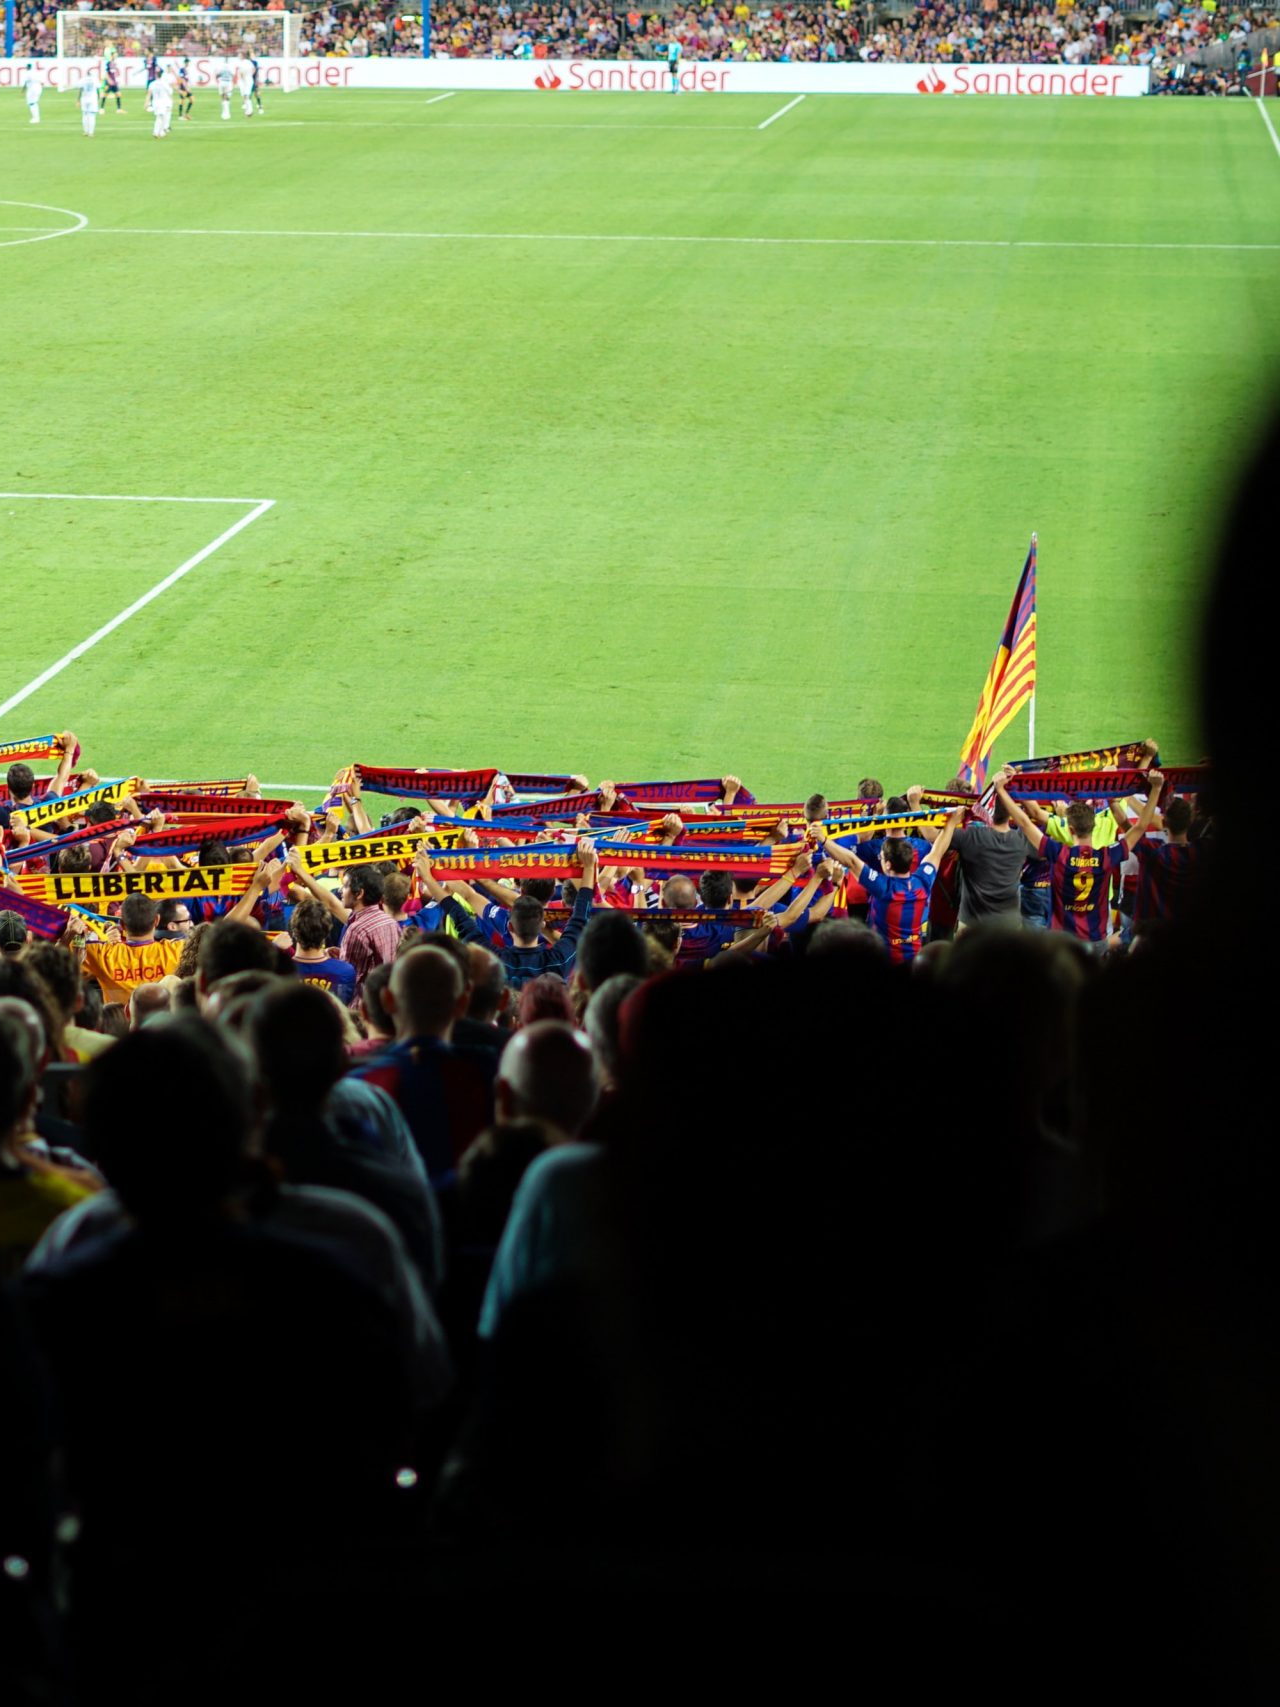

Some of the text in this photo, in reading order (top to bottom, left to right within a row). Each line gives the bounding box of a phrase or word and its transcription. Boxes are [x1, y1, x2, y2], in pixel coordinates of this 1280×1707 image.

[196, 59, 354, 87] Sander
[952, 66, 1124, 96] Santander
[25, 780, 126, 826] LLIBERTAT
[304, 833, 460, 867] LLIBERTAT
[54, 868, 226, 900] LLIBERTAT
[1072, 871, 1095, 902] 9
